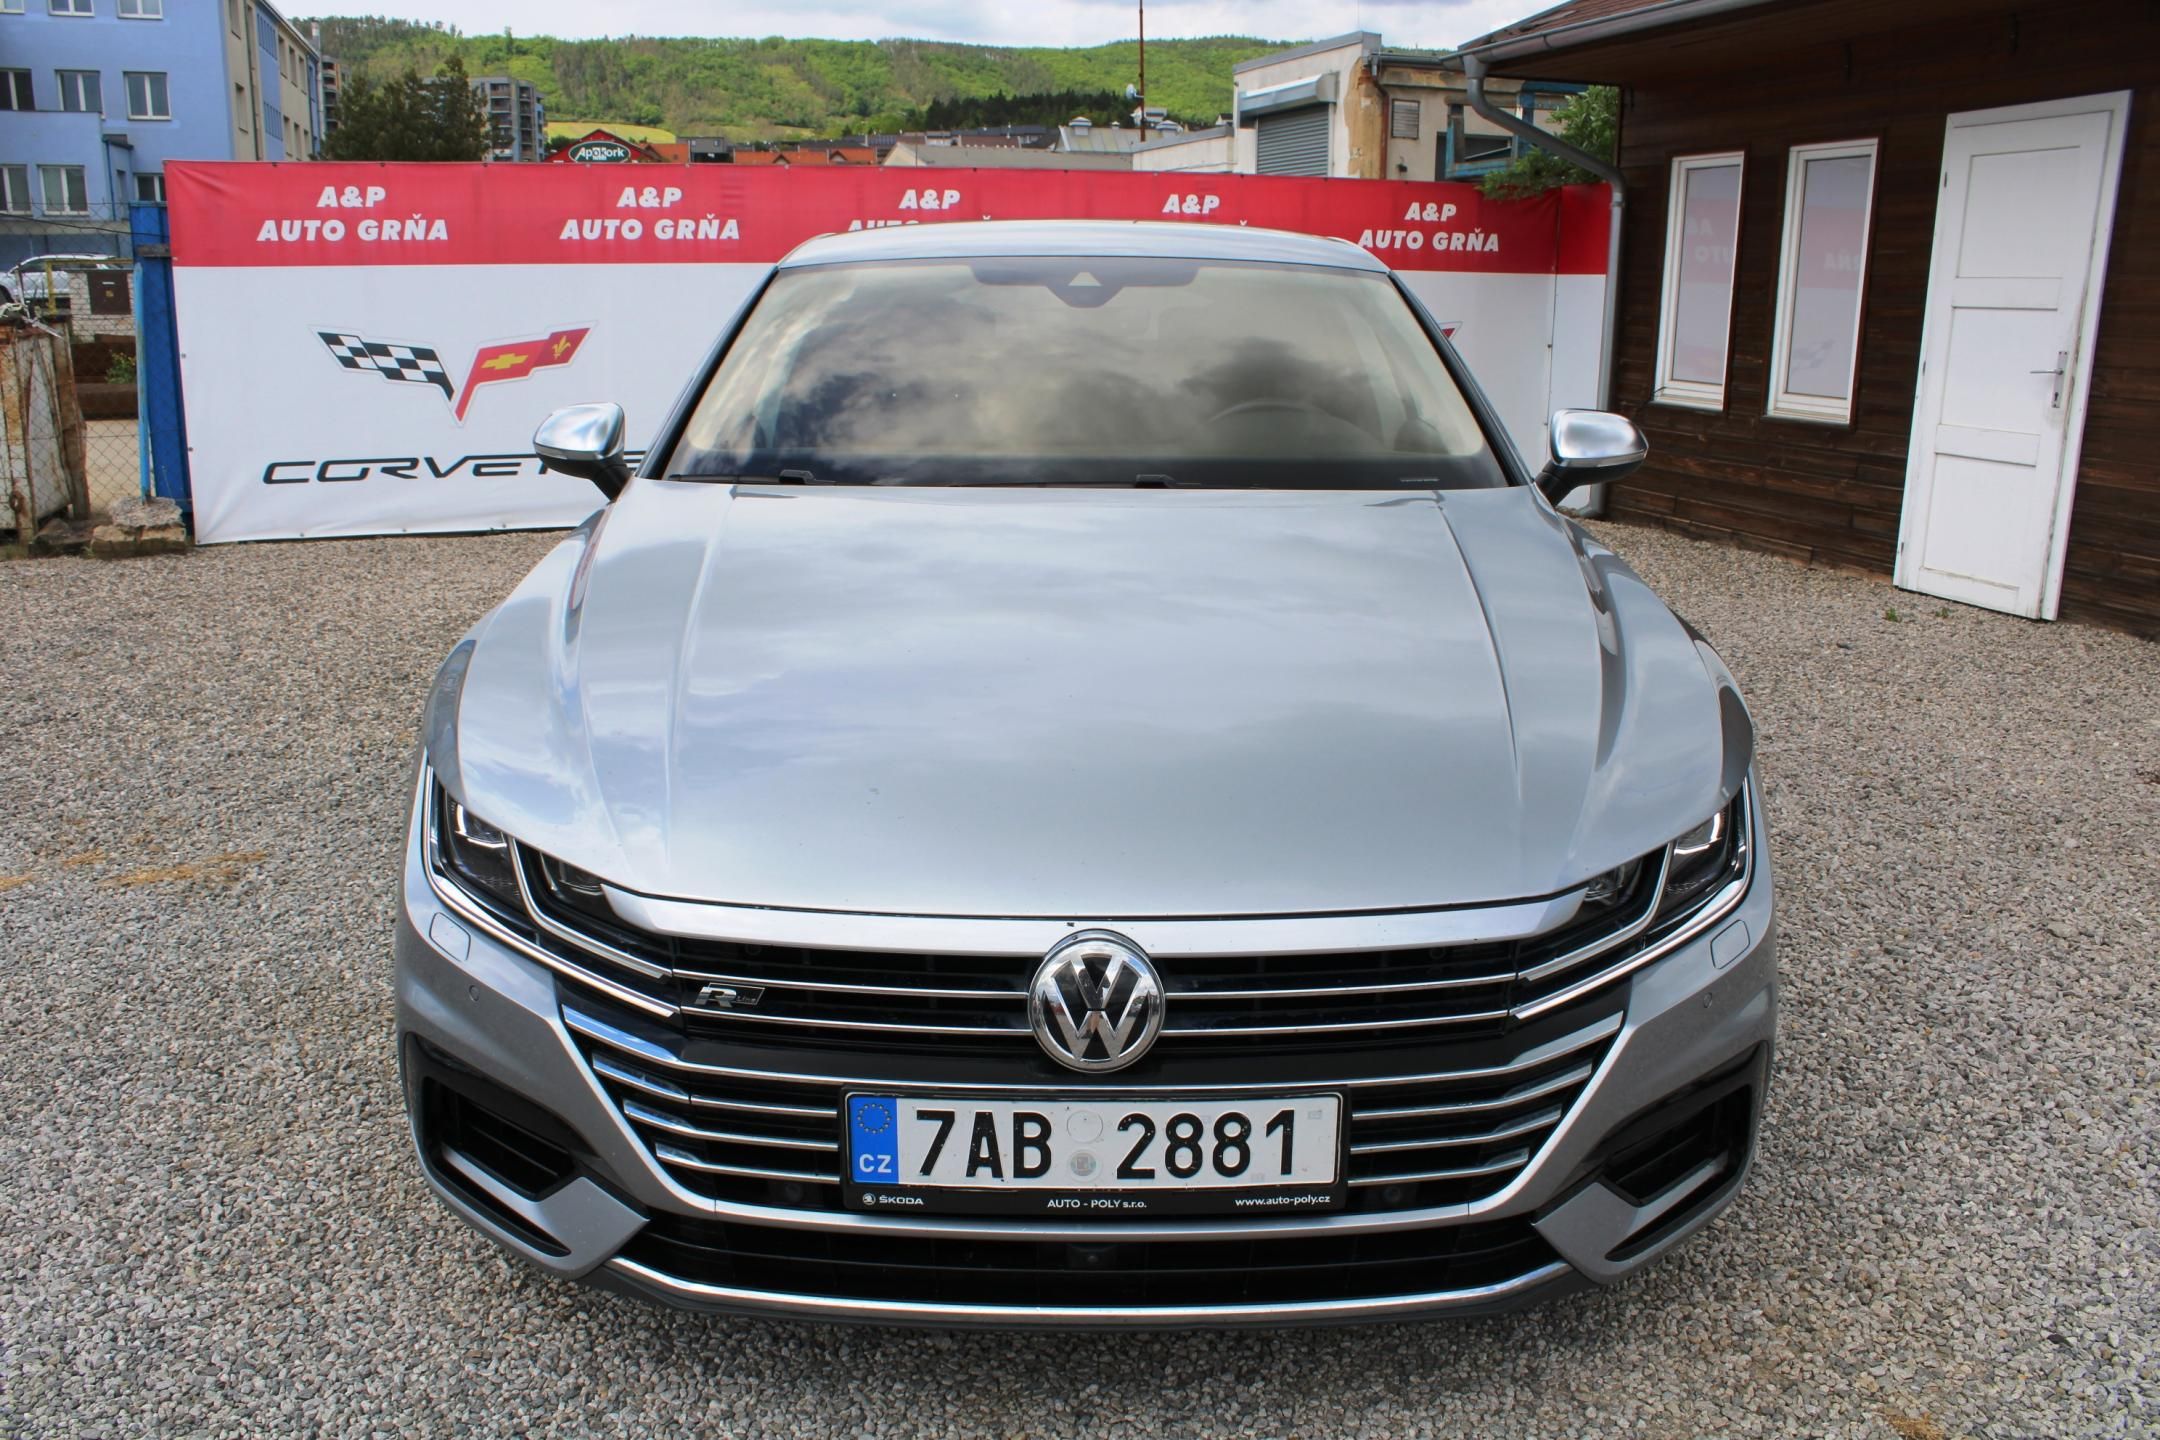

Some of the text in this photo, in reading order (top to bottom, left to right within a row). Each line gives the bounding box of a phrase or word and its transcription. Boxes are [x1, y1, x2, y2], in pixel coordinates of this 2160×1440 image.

[316, 186, 386, 208] A&P
[616, 187, 682, 208] A&P
[898, 189, 960, 209] A&P
[1162, 194, 1220, 214] A&P
[1404, 202, 1457, 222] A&P
[256, 213, 448, 242] AUTO GRŇA
[559, 213, 740, 240] AUTO GRŇA
[1358, 227, 1499, 252] AUTO GRŇA
[262, 450, 646, 485] CORVE
[916, 1109, 1295, 1179] 7AB 2881
[859, 1153, 892, 1173] CZ
[879, 1194, 925, 1206] ŠKODA
[1047, 1199, 1081, 1208] AUTO
[1091, 1199, 1121, 1208] POLY
[1122, 1200, 1147, 1209] s.r.o.
[1235, 1194, 1331, 1207] www.auto-poly.cz
